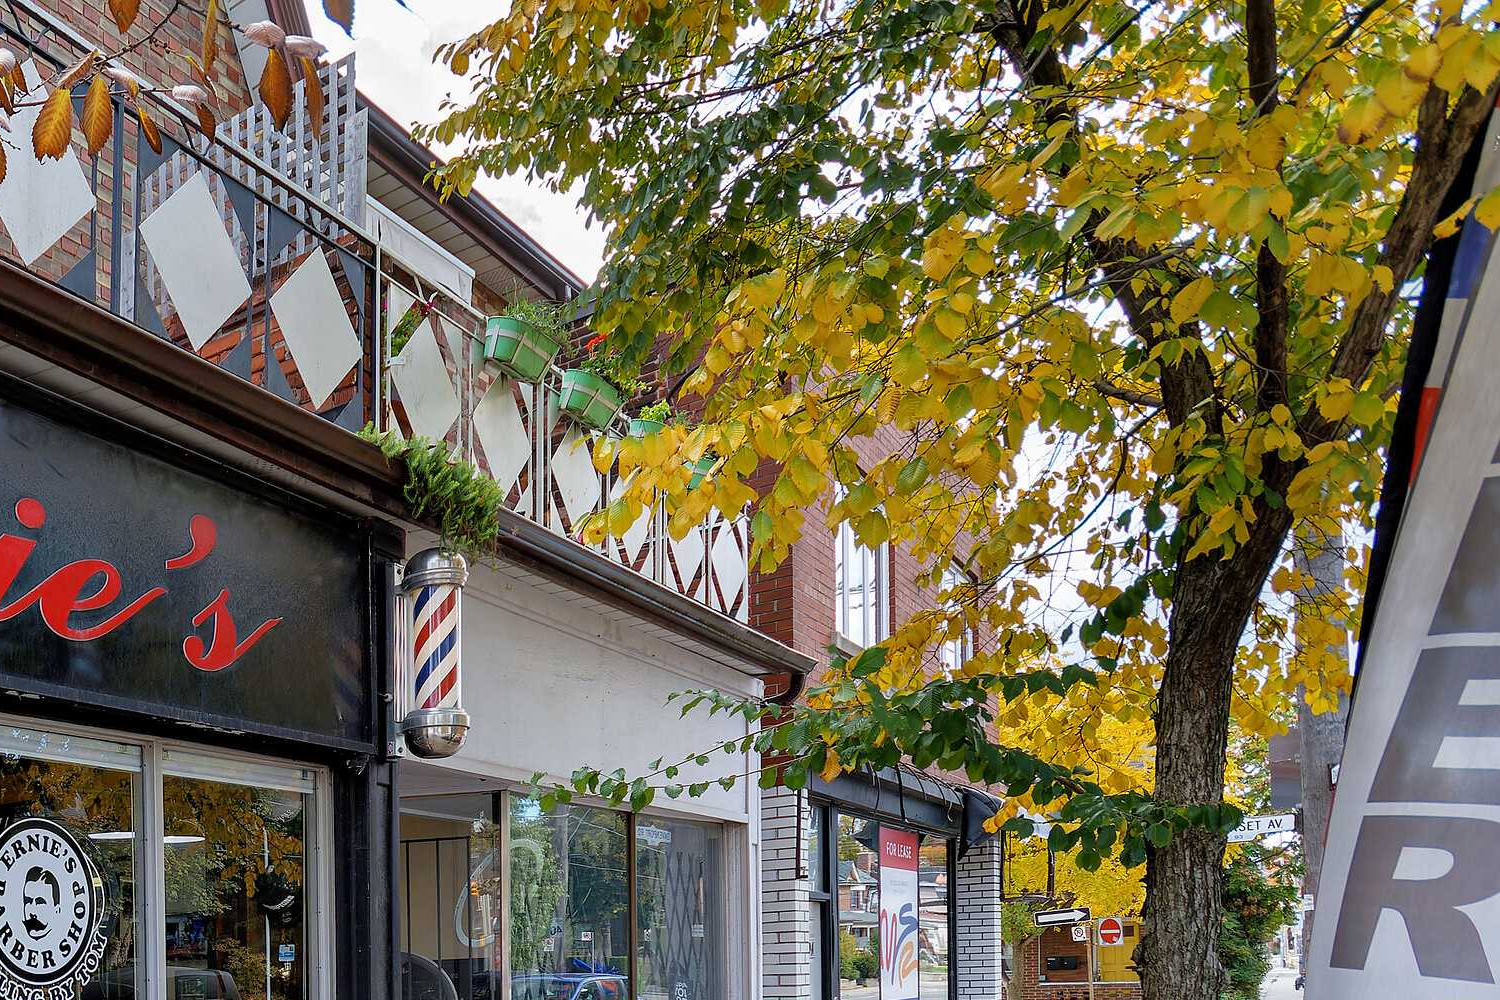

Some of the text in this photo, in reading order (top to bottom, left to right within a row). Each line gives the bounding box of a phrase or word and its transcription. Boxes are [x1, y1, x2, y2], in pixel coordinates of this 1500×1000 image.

[1234, 820, 1261, 832] SET
[0, 834, 77, 874] ERNIE'S
[886, 842, 912, 859] FOR LEASE
[59, 881, 86, 958] SHOP
[76, 931, 107, 986] TOM
